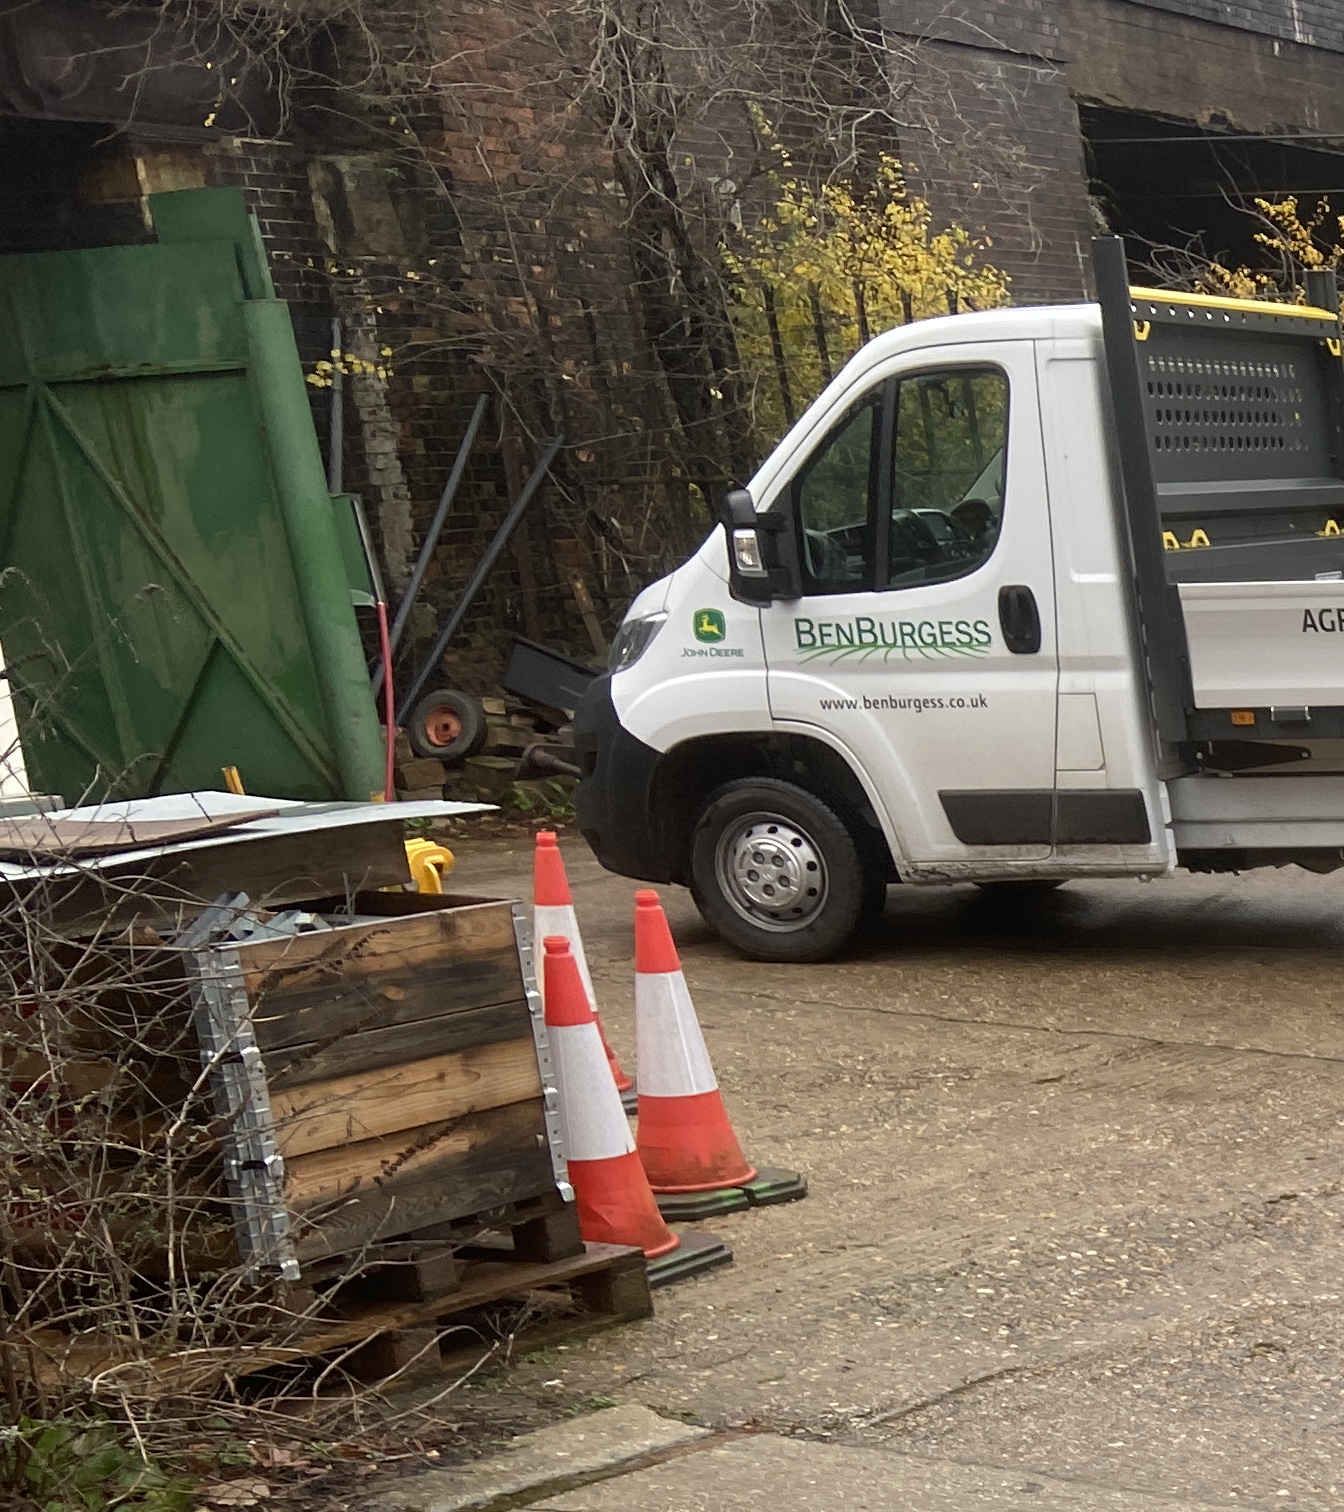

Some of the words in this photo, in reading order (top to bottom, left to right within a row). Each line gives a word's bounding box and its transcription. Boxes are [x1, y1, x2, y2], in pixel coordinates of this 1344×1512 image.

[680, 647, 708, 658] JOHN
[709, 648, 744, 658] DEERE
[819, 693, 988, 713] www.benburgess.co.uk
